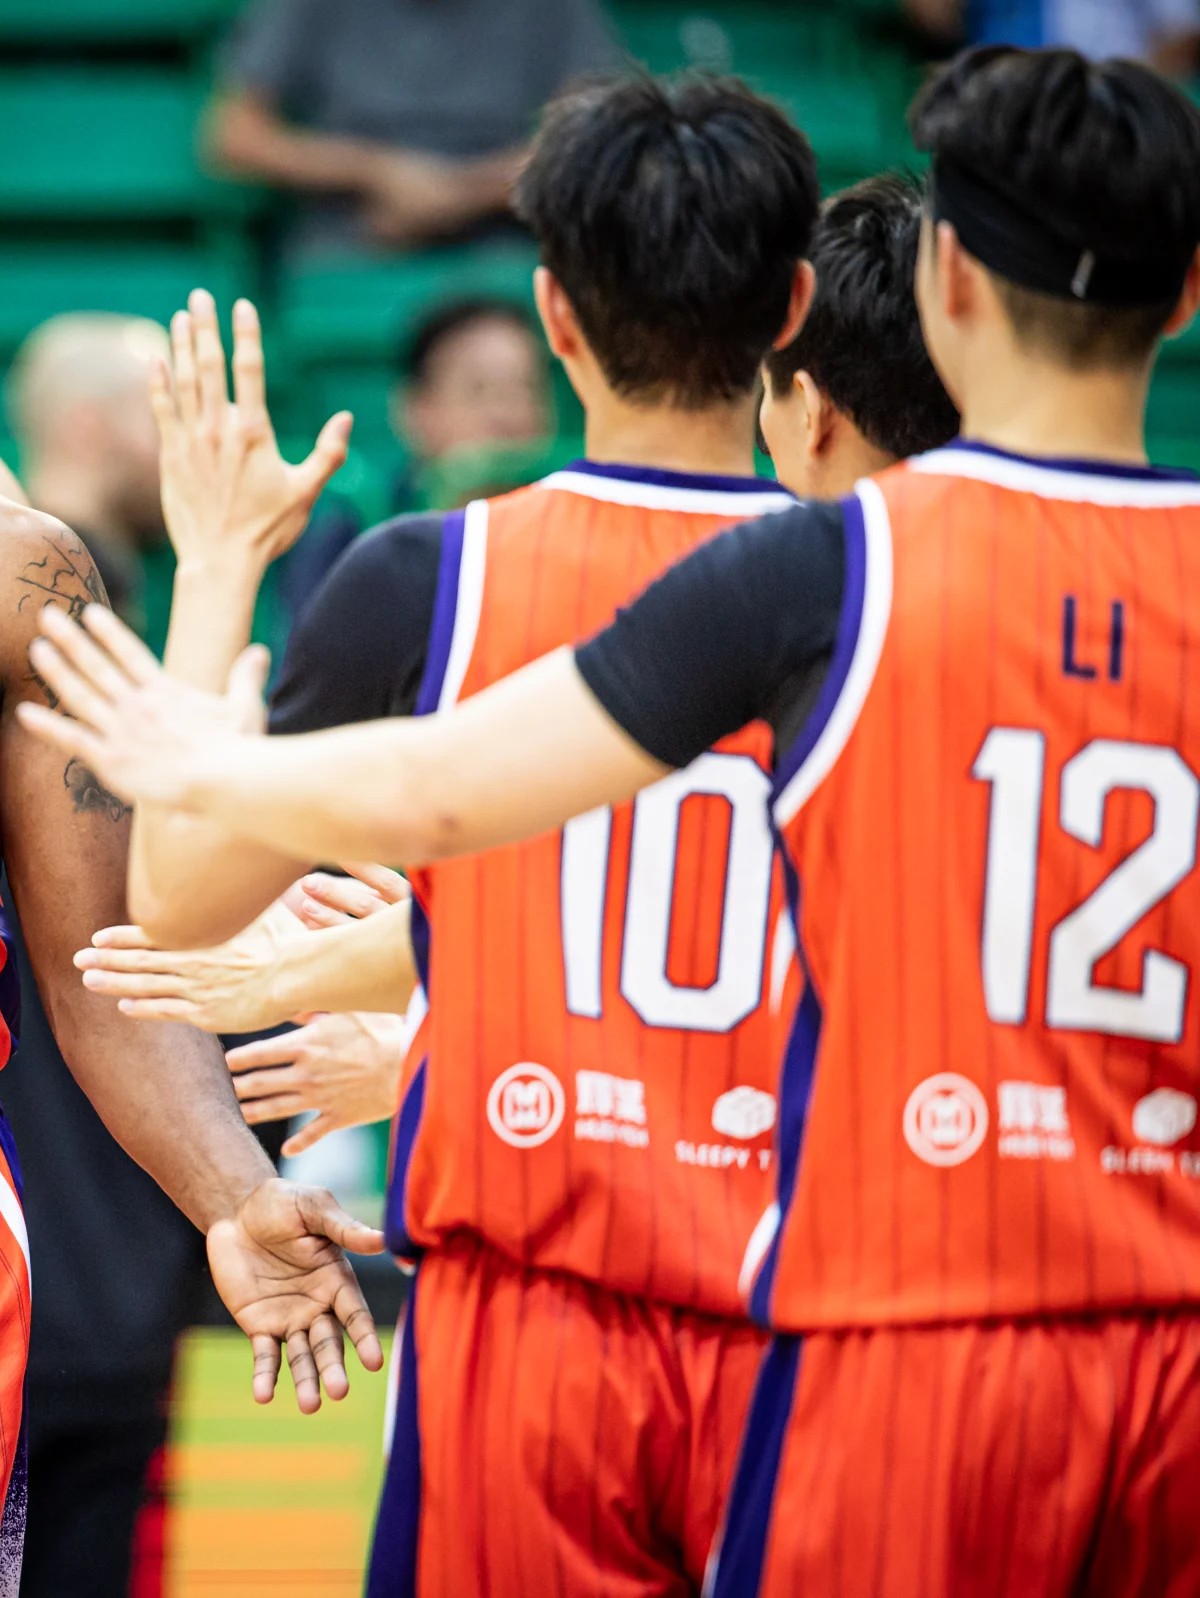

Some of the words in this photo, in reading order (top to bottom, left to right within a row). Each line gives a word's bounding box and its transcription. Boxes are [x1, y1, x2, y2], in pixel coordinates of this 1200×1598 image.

[1063, 595, 1123, 682] LI
[558, 751, 775, 1034] 10
[970, 726, 1200, 1044] 12
